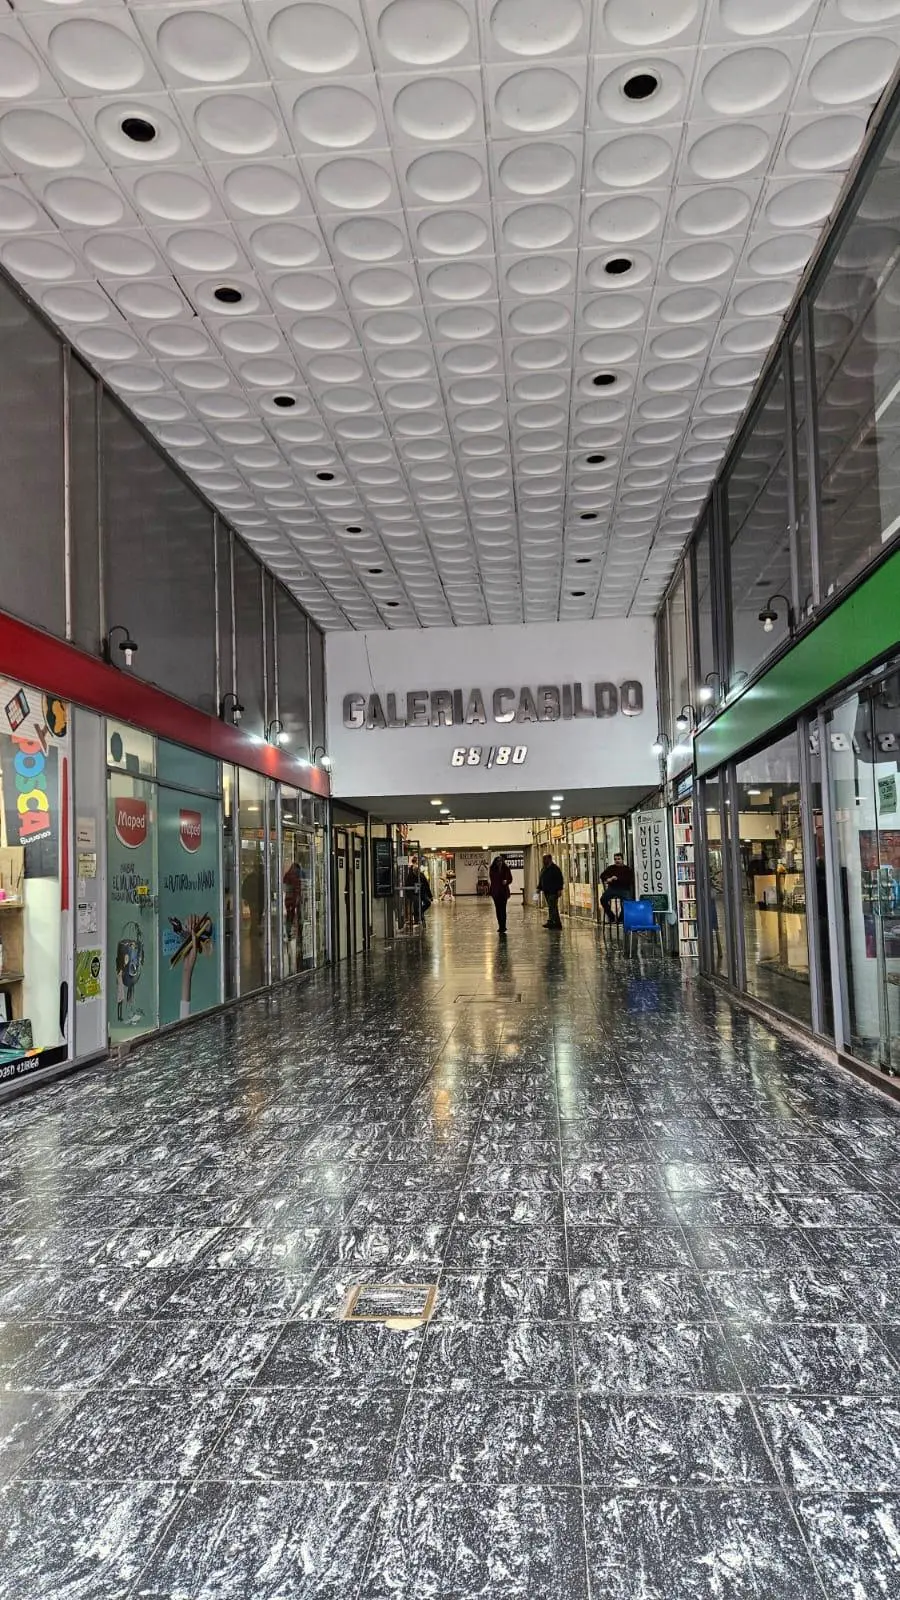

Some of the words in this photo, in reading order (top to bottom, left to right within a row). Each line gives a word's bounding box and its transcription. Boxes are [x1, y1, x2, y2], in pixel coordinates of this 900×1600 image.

[343, 687, 487, 730] GALERIA
[492, 680, 643, 723] CABILDO
[451, 745, 528, 769] 68/80
[11, 735, 50, 836] POSCA
[117, 811, 145, 830] Maped
[180, 822, 201, 838] Maped
[640, 825, 649, 893] NUEVOS
[653, 824, 663, 893] USADOS
